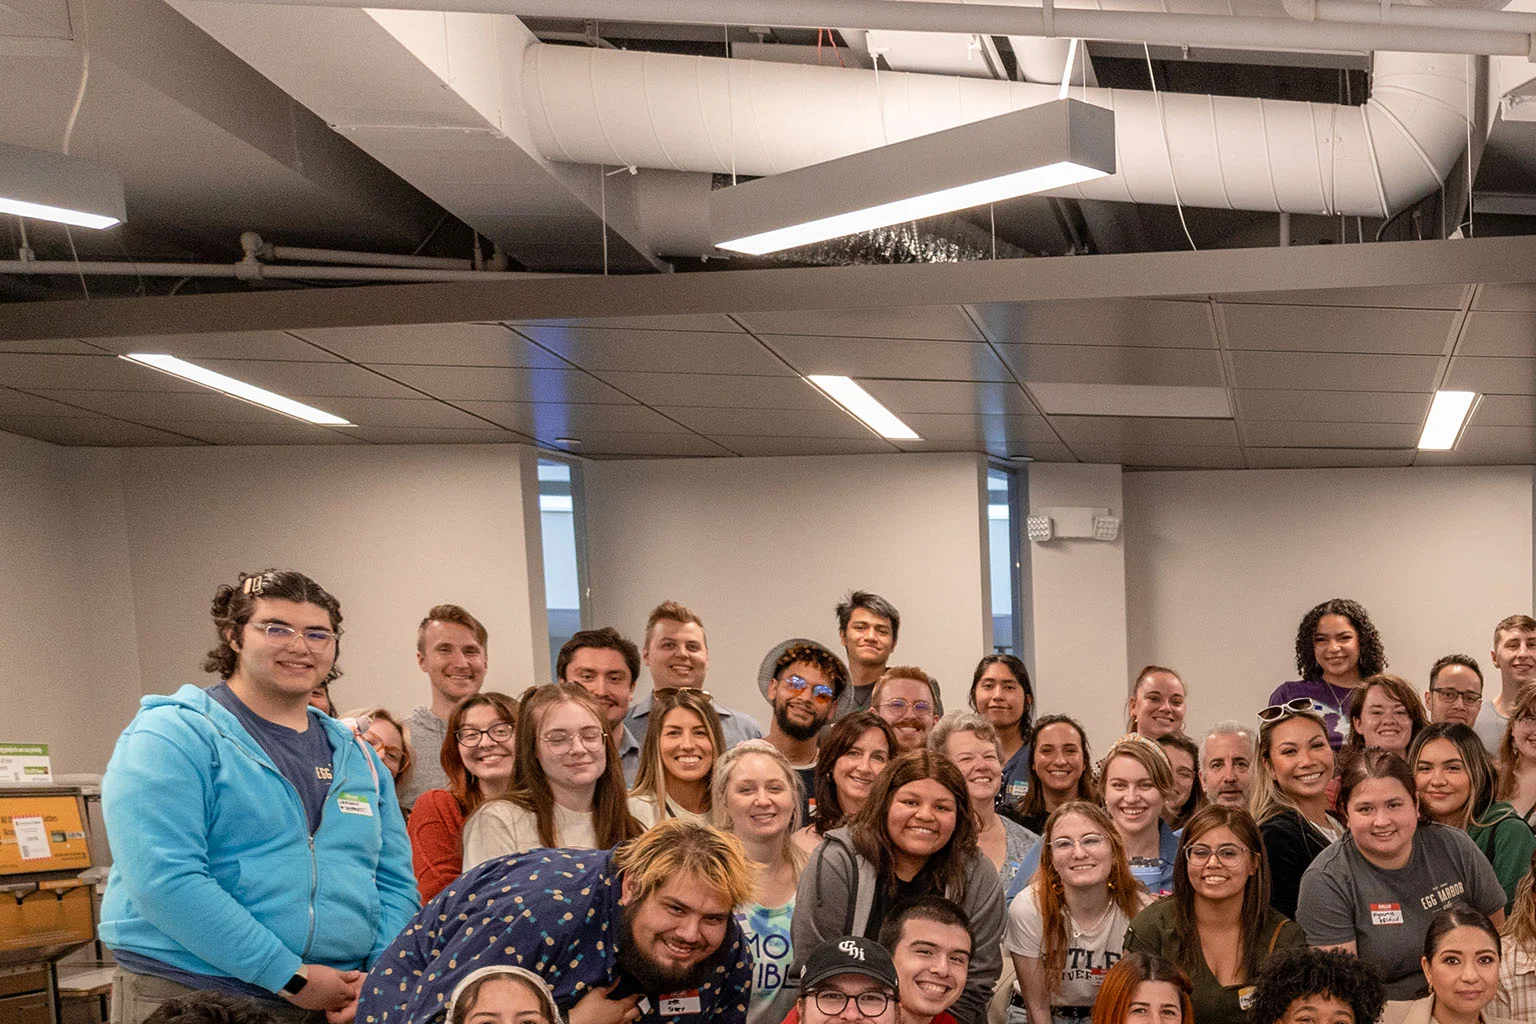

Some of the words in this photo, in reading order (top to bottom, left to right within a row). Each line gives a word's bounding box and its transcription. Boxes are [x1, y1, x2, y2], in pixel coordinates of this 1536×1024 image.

[316, 766, 334, 780] EGG
[1420, 894, 1438, 911] EGG
[1437, 882, 1465, 902] HARBOR
